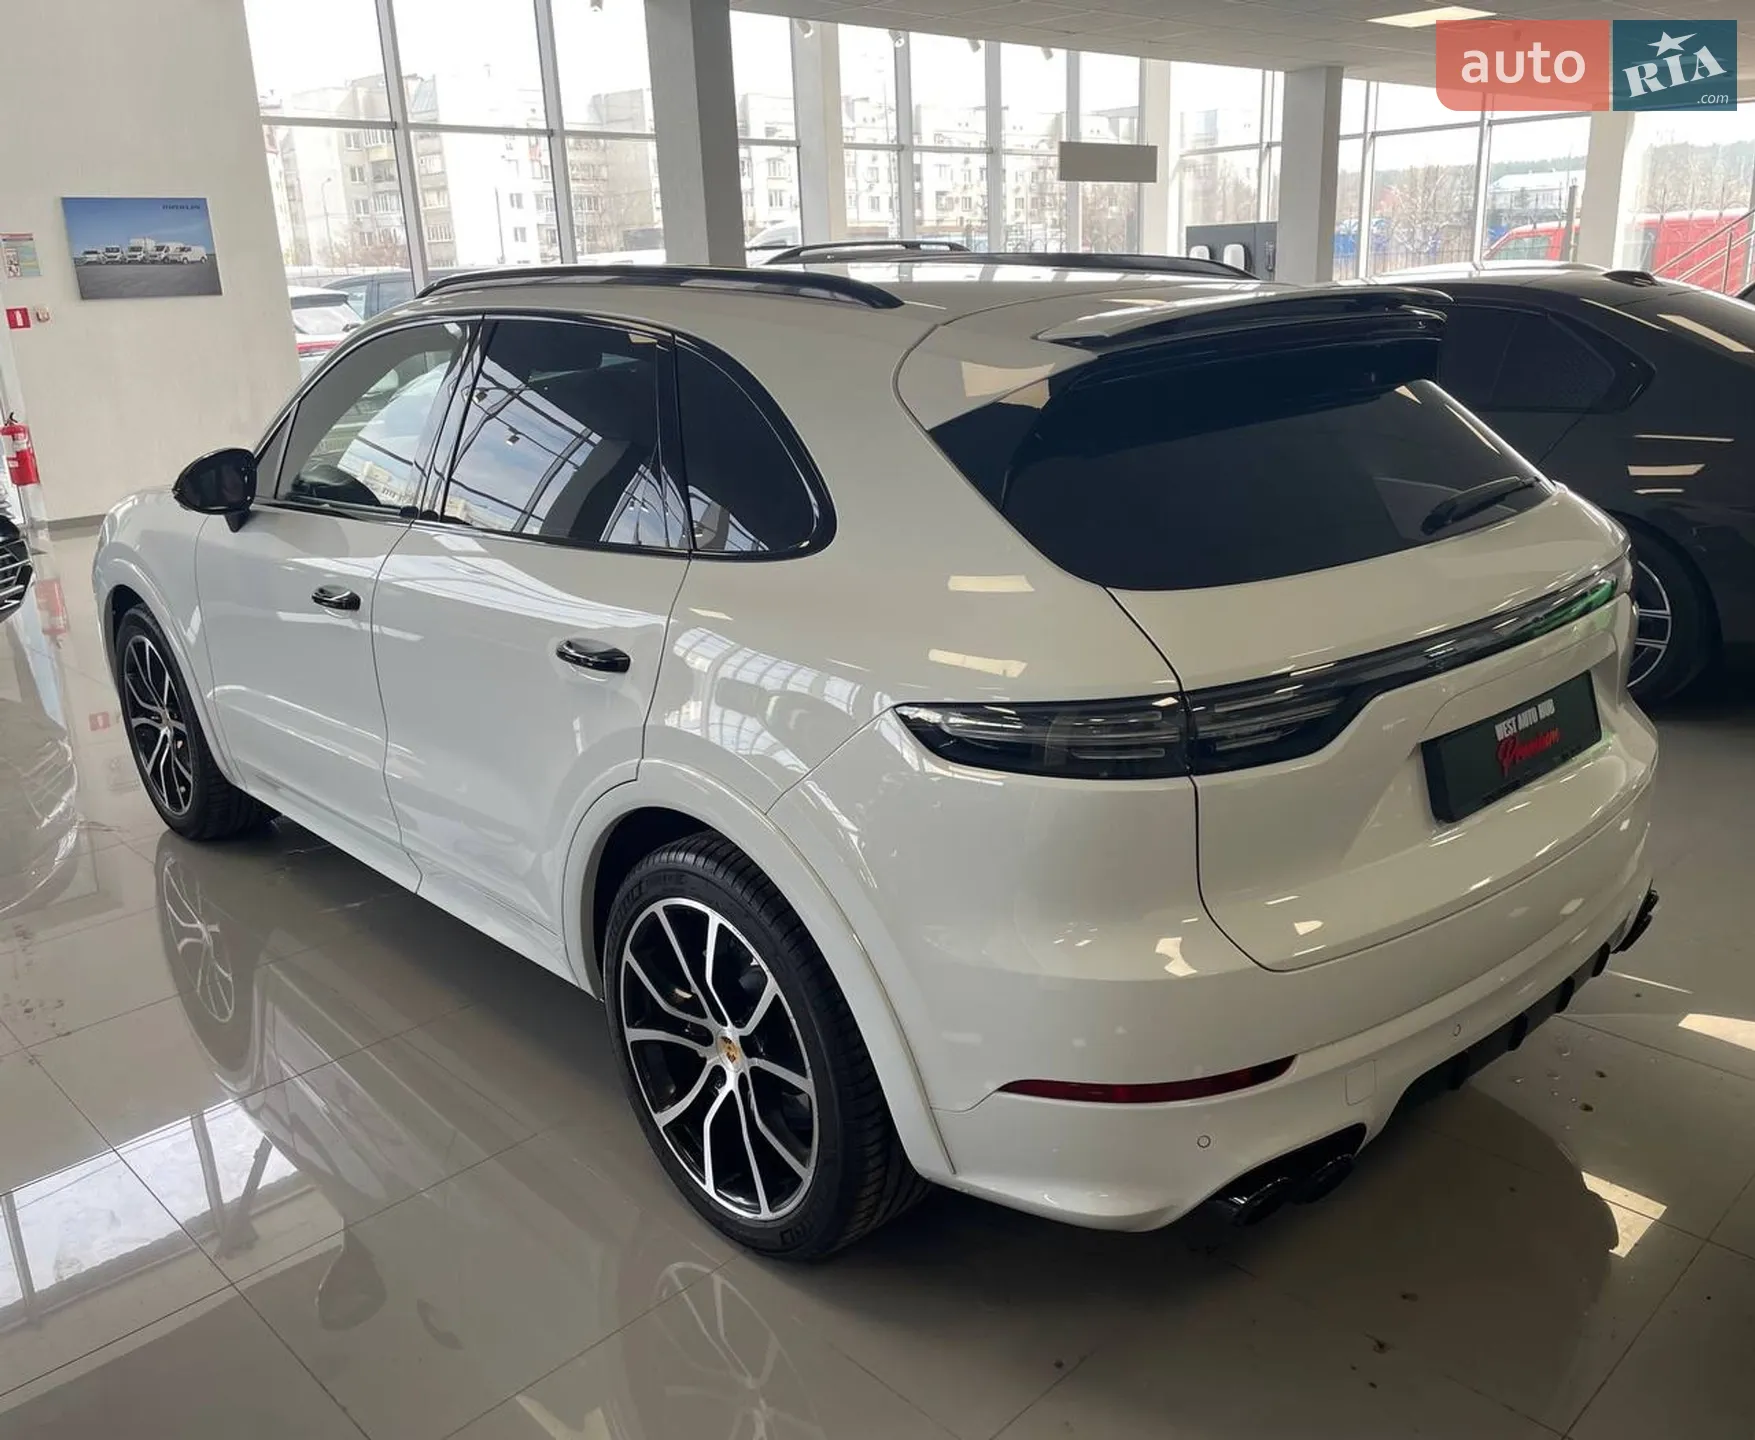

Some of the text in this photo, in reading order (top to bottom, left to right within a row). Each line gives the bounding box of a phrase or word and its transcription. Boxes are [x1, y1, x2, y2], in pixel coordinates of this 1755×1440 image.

[1494, 698, 1556, 741] WEST AUTO HUB
[1496, 728, 1560, 778] Premium
